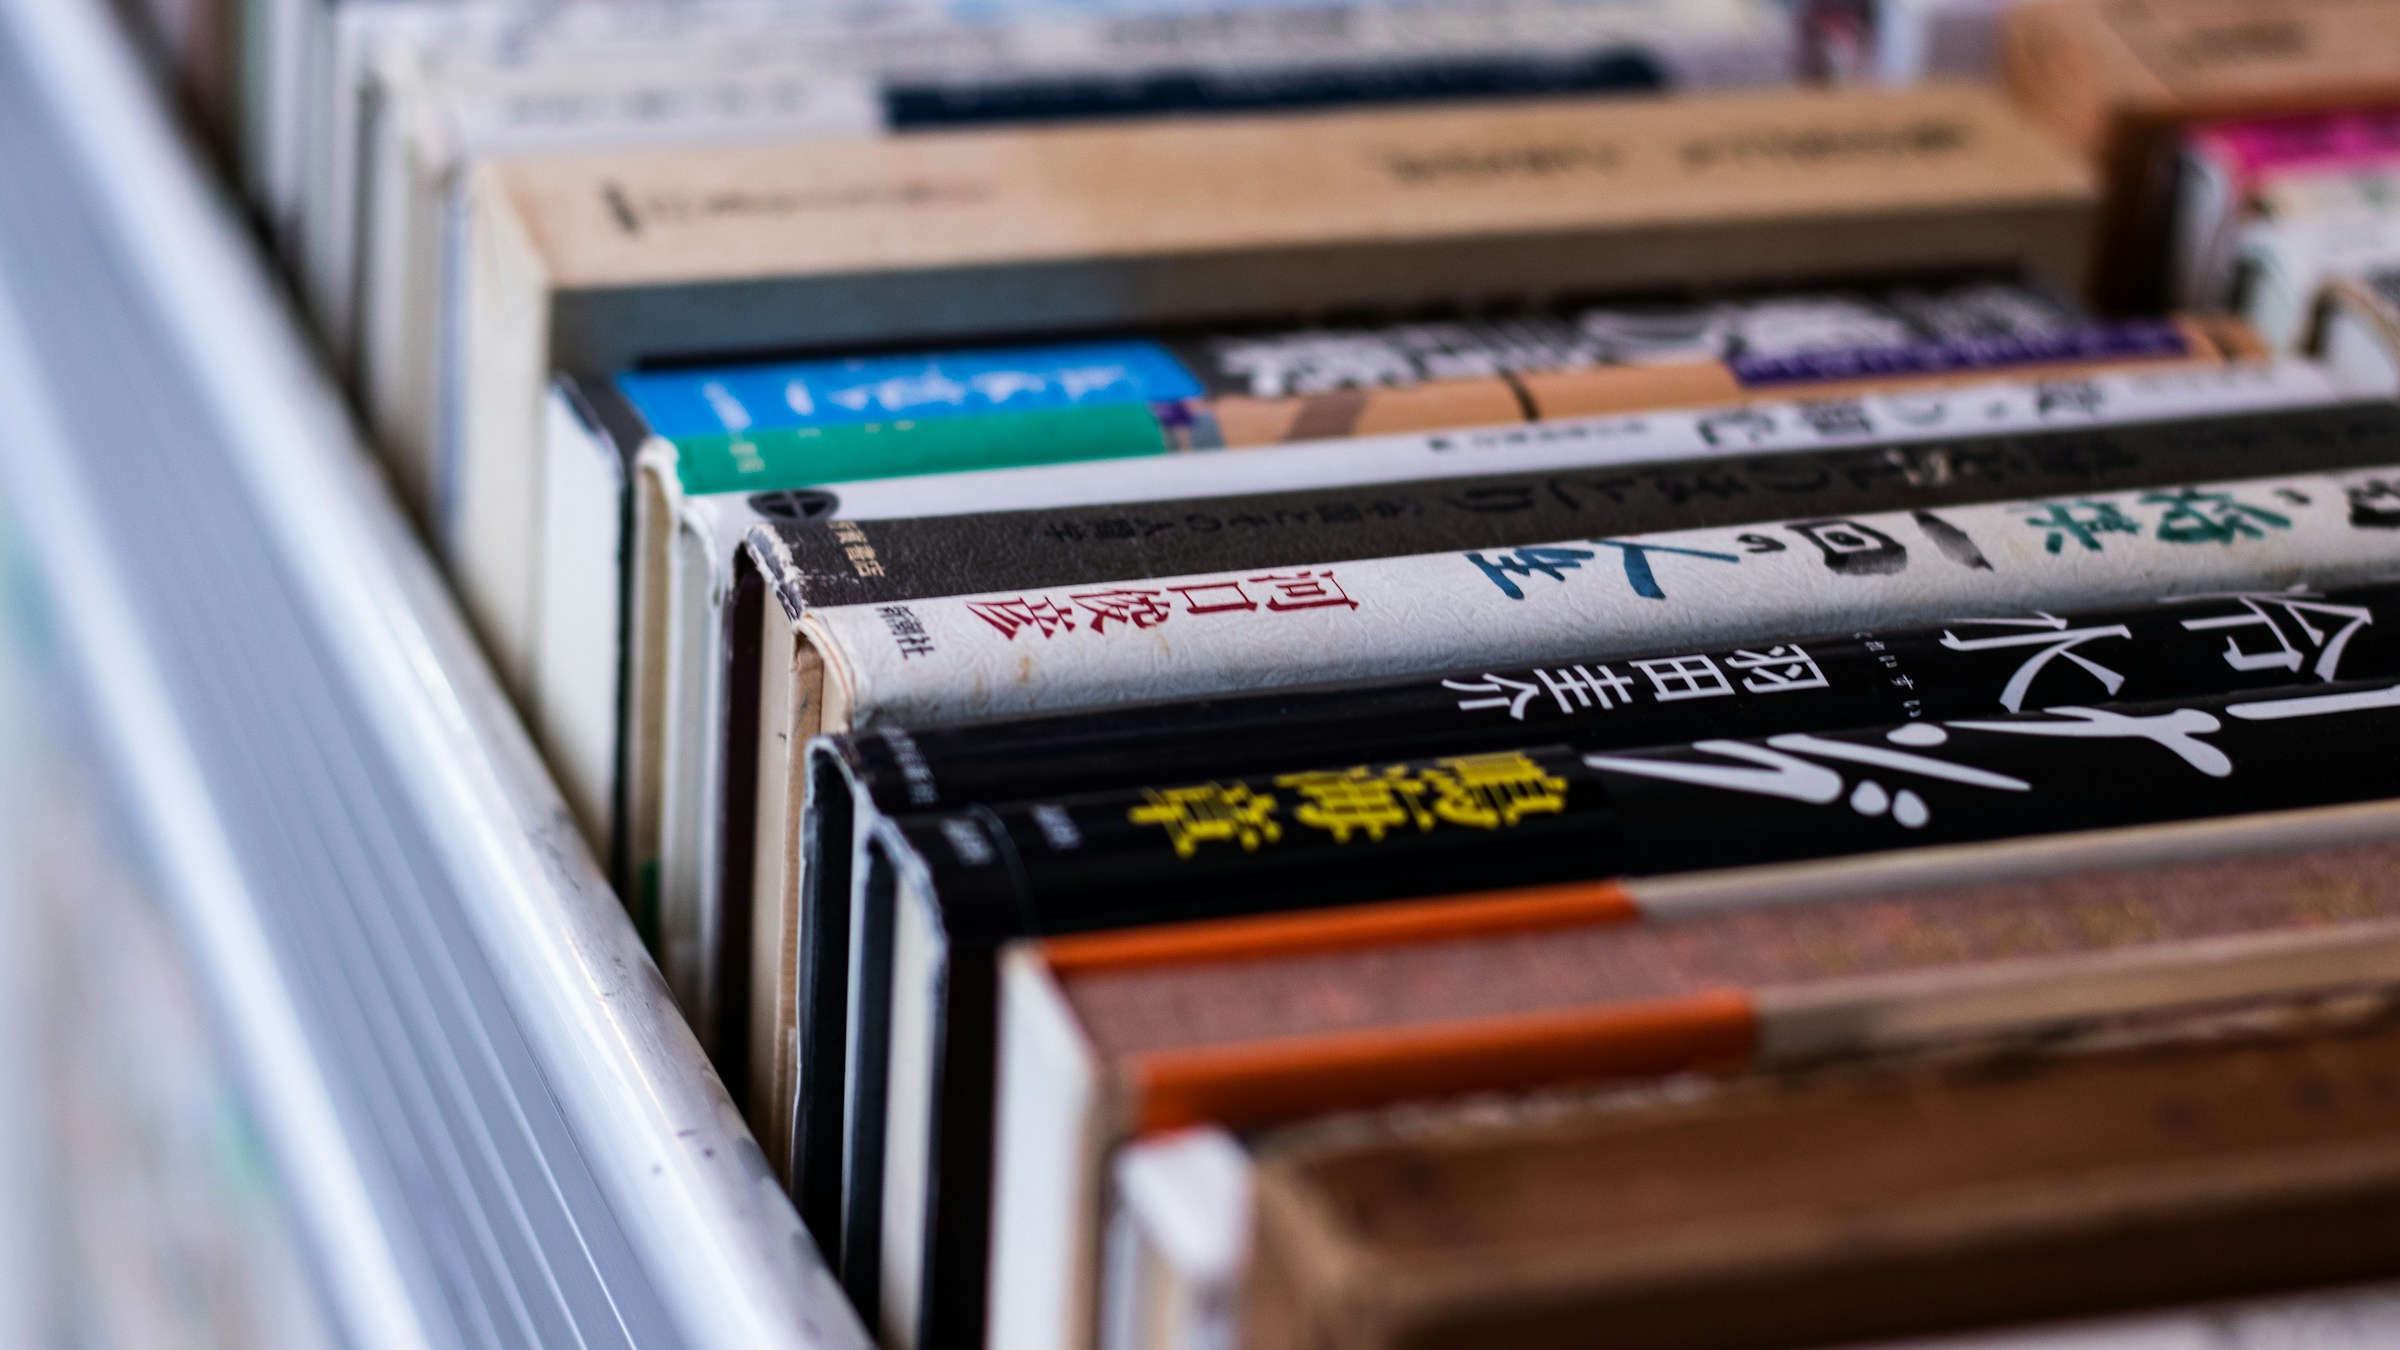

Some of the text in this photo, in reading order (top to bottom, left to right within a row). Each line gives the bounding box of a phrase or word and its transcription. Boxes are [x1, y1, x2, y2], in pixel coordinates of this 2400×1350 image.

[874, 604, 935, 661] 新潮社
[967, 571, 1359, 640] 河口俊彦
[1441, 643, 1830, 720] 羽田圭介
[1128, 750, 1568, 857] 鳴海章
